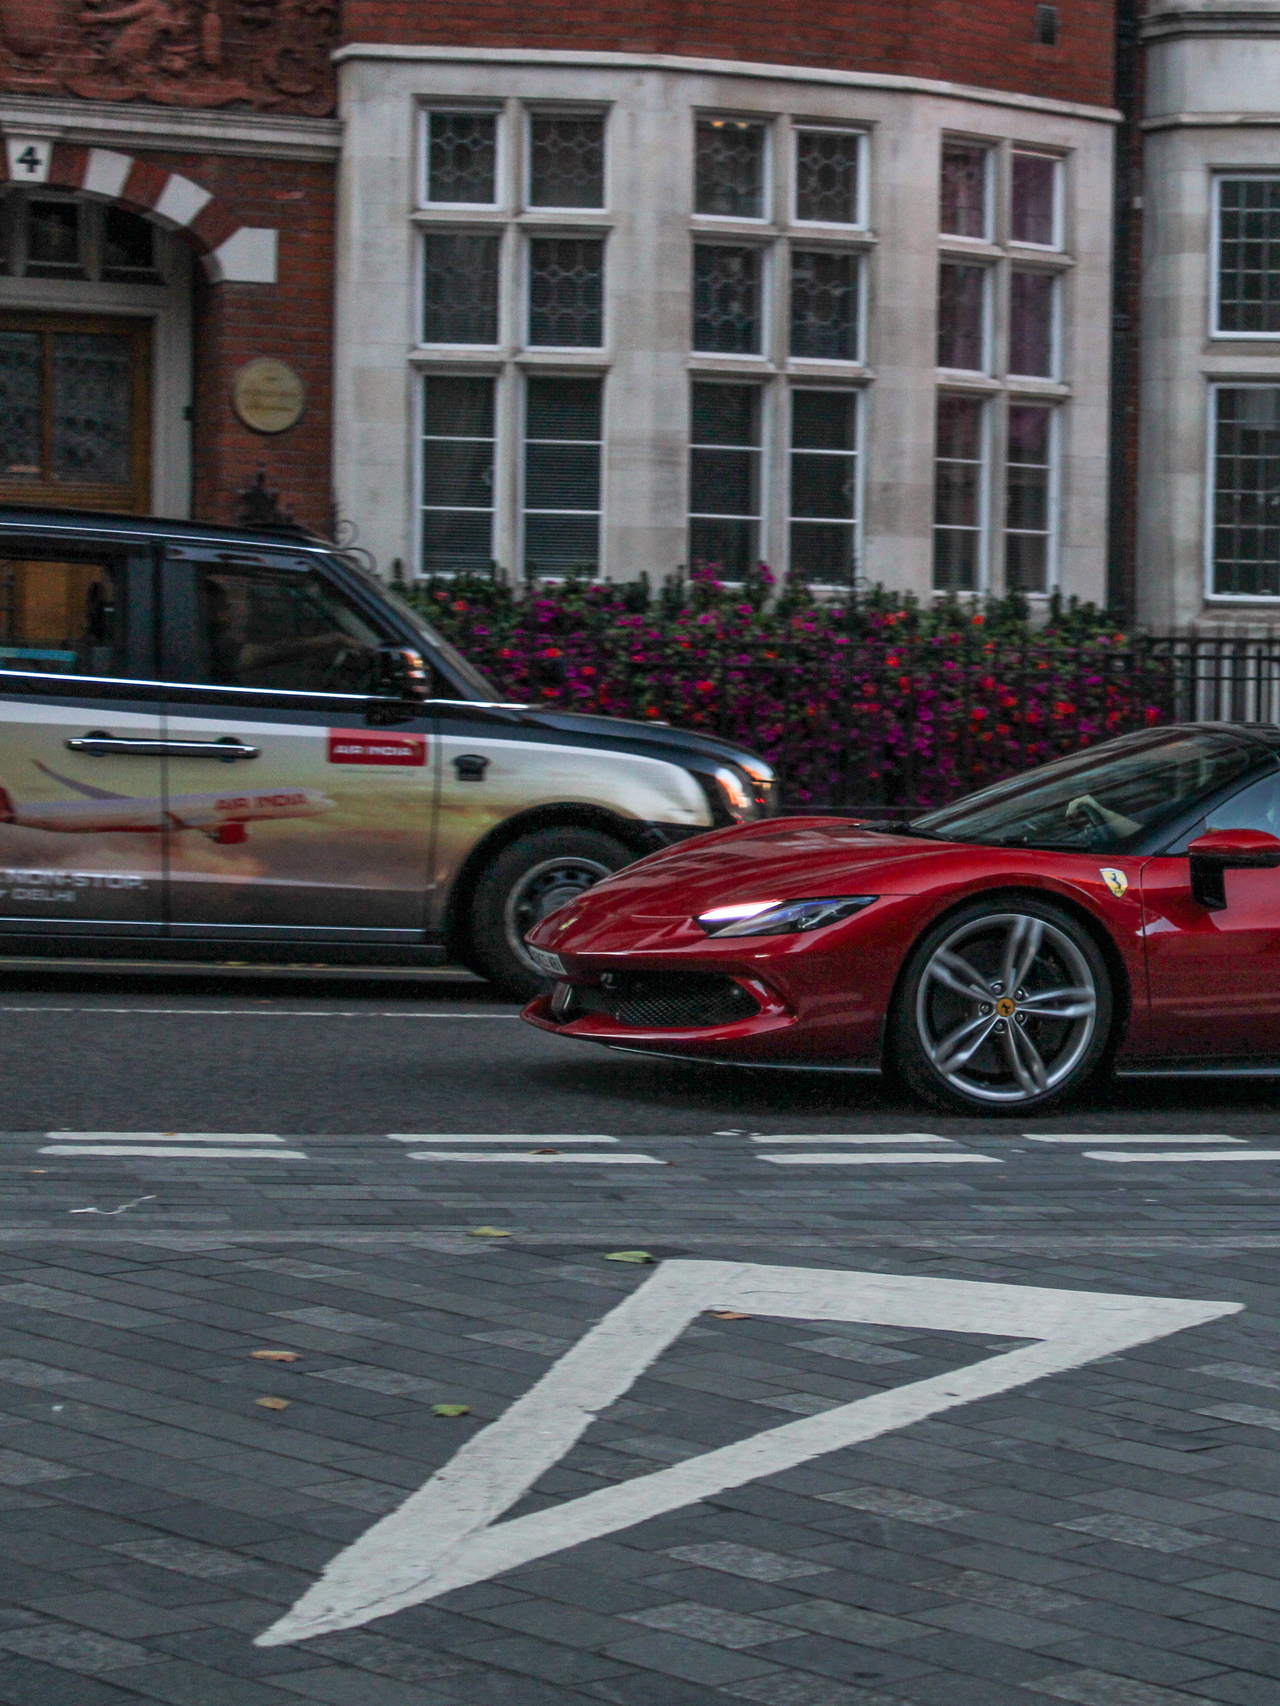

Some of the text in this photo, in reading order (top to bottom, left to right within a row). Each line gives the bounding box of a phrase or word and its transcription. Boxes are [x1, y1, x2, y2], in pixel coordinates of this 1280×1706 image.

[15, 146, 42, 173] 4
[333, 744, 414, 757] AIR INDIA
[214, 793, 308, 811] AIR INDIA
[11, 887, 77, 902] DELHI
